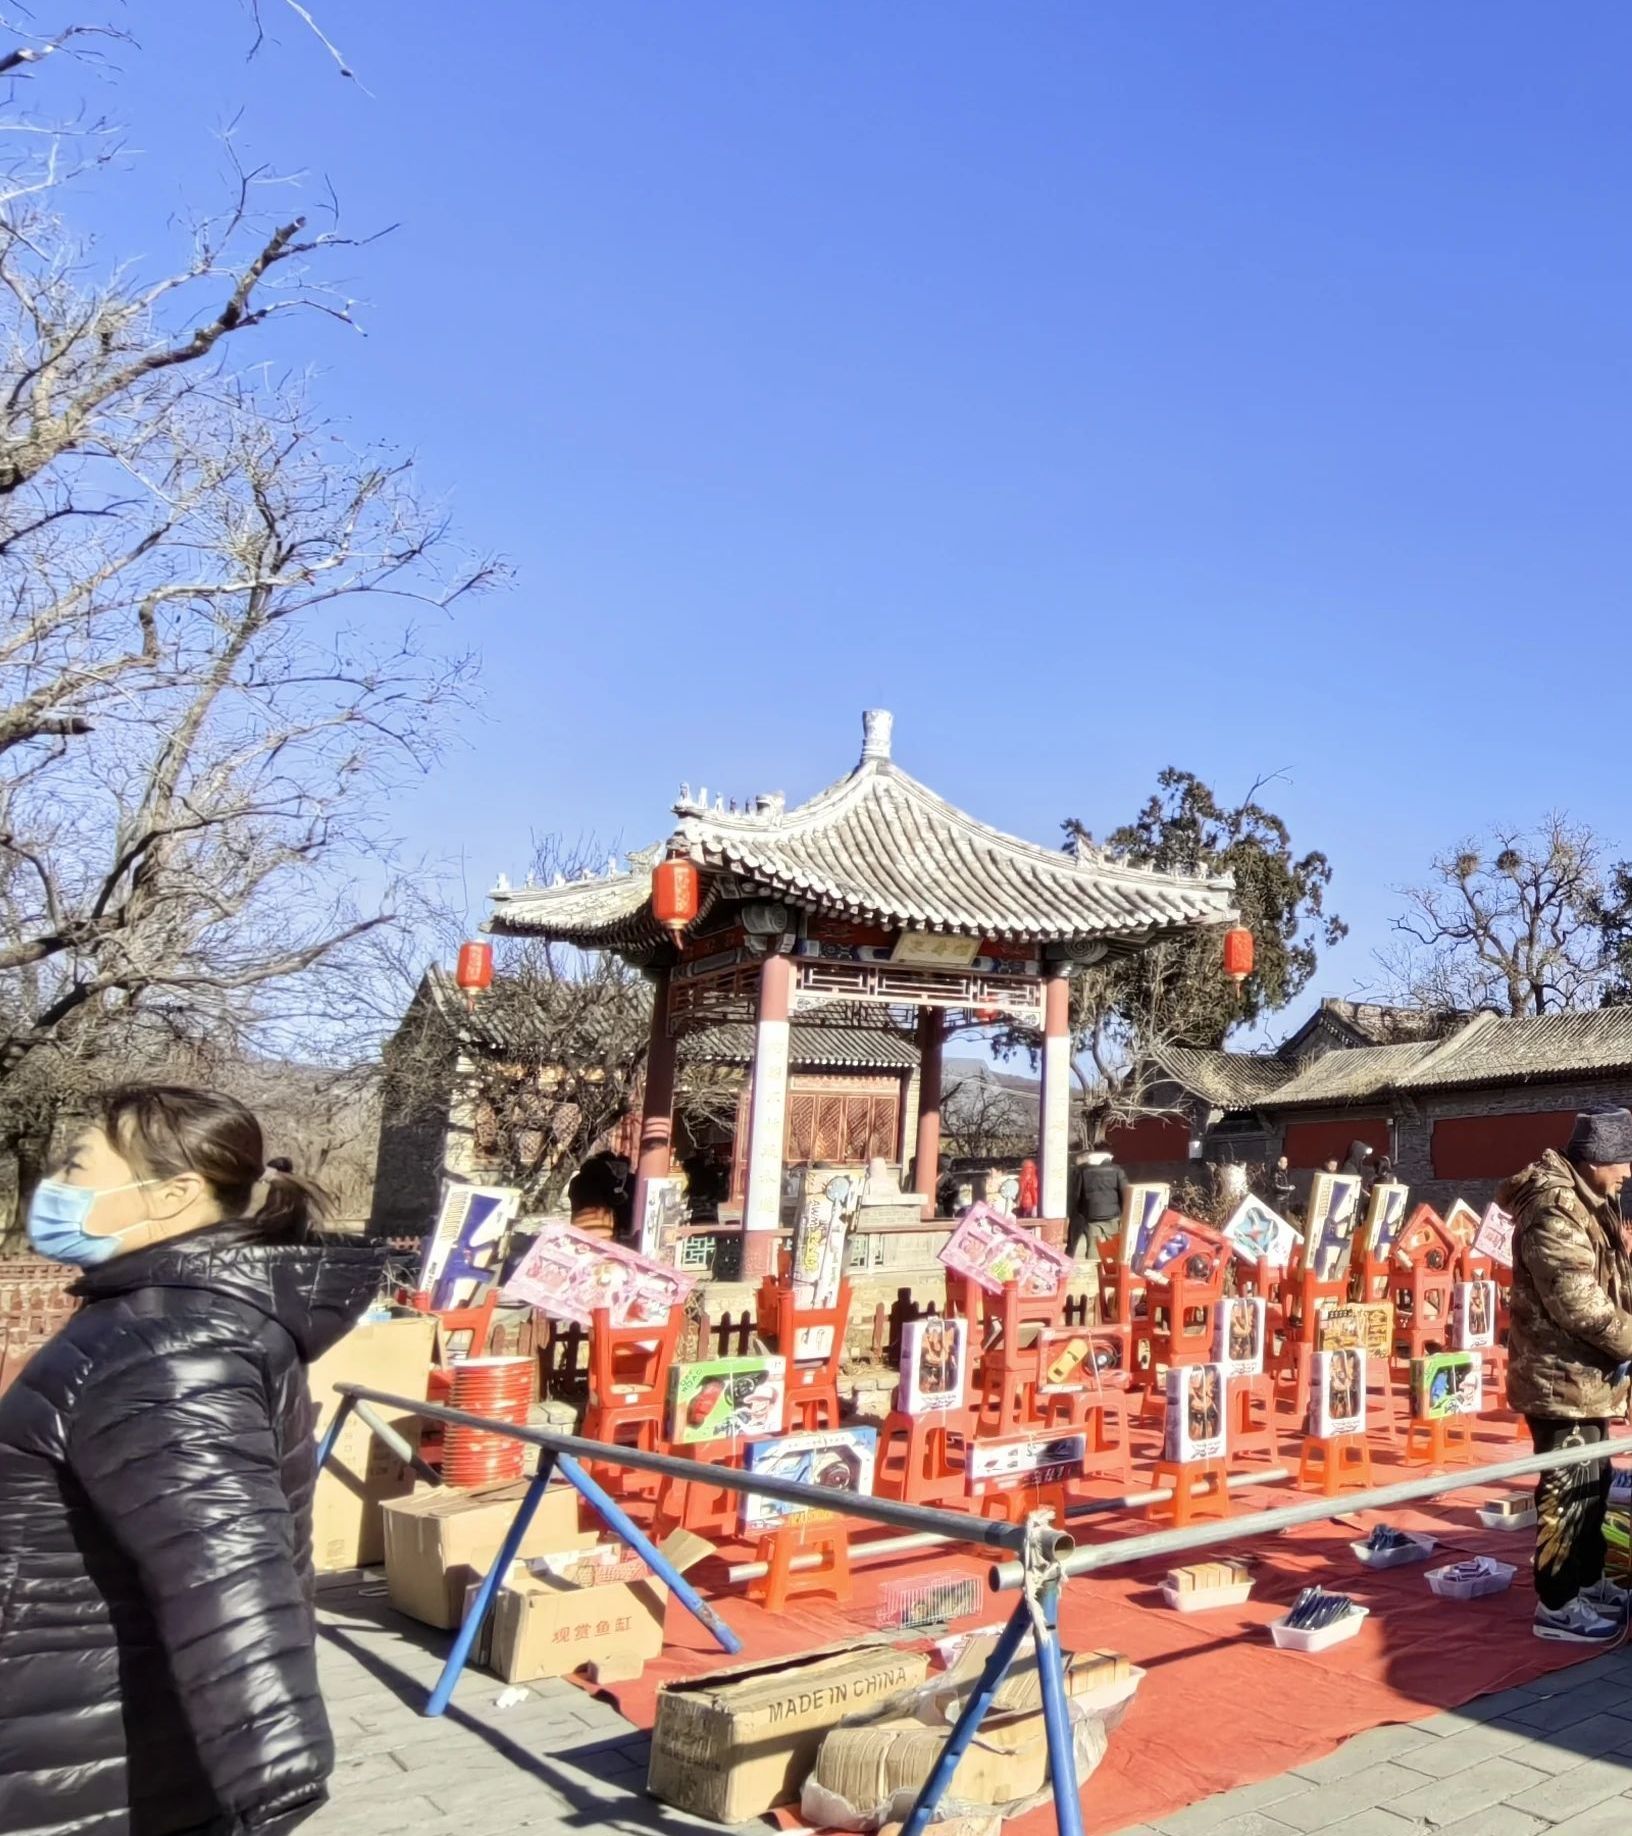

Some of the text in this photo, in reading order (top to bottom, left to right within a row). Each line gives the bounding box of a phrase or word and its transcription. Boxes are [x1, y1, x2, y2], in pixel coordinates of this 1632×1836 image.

[552, 1616, 632, 1643] 观赏鱼缸
[768, 1667, 906, 1723] MADE IN CHINA
